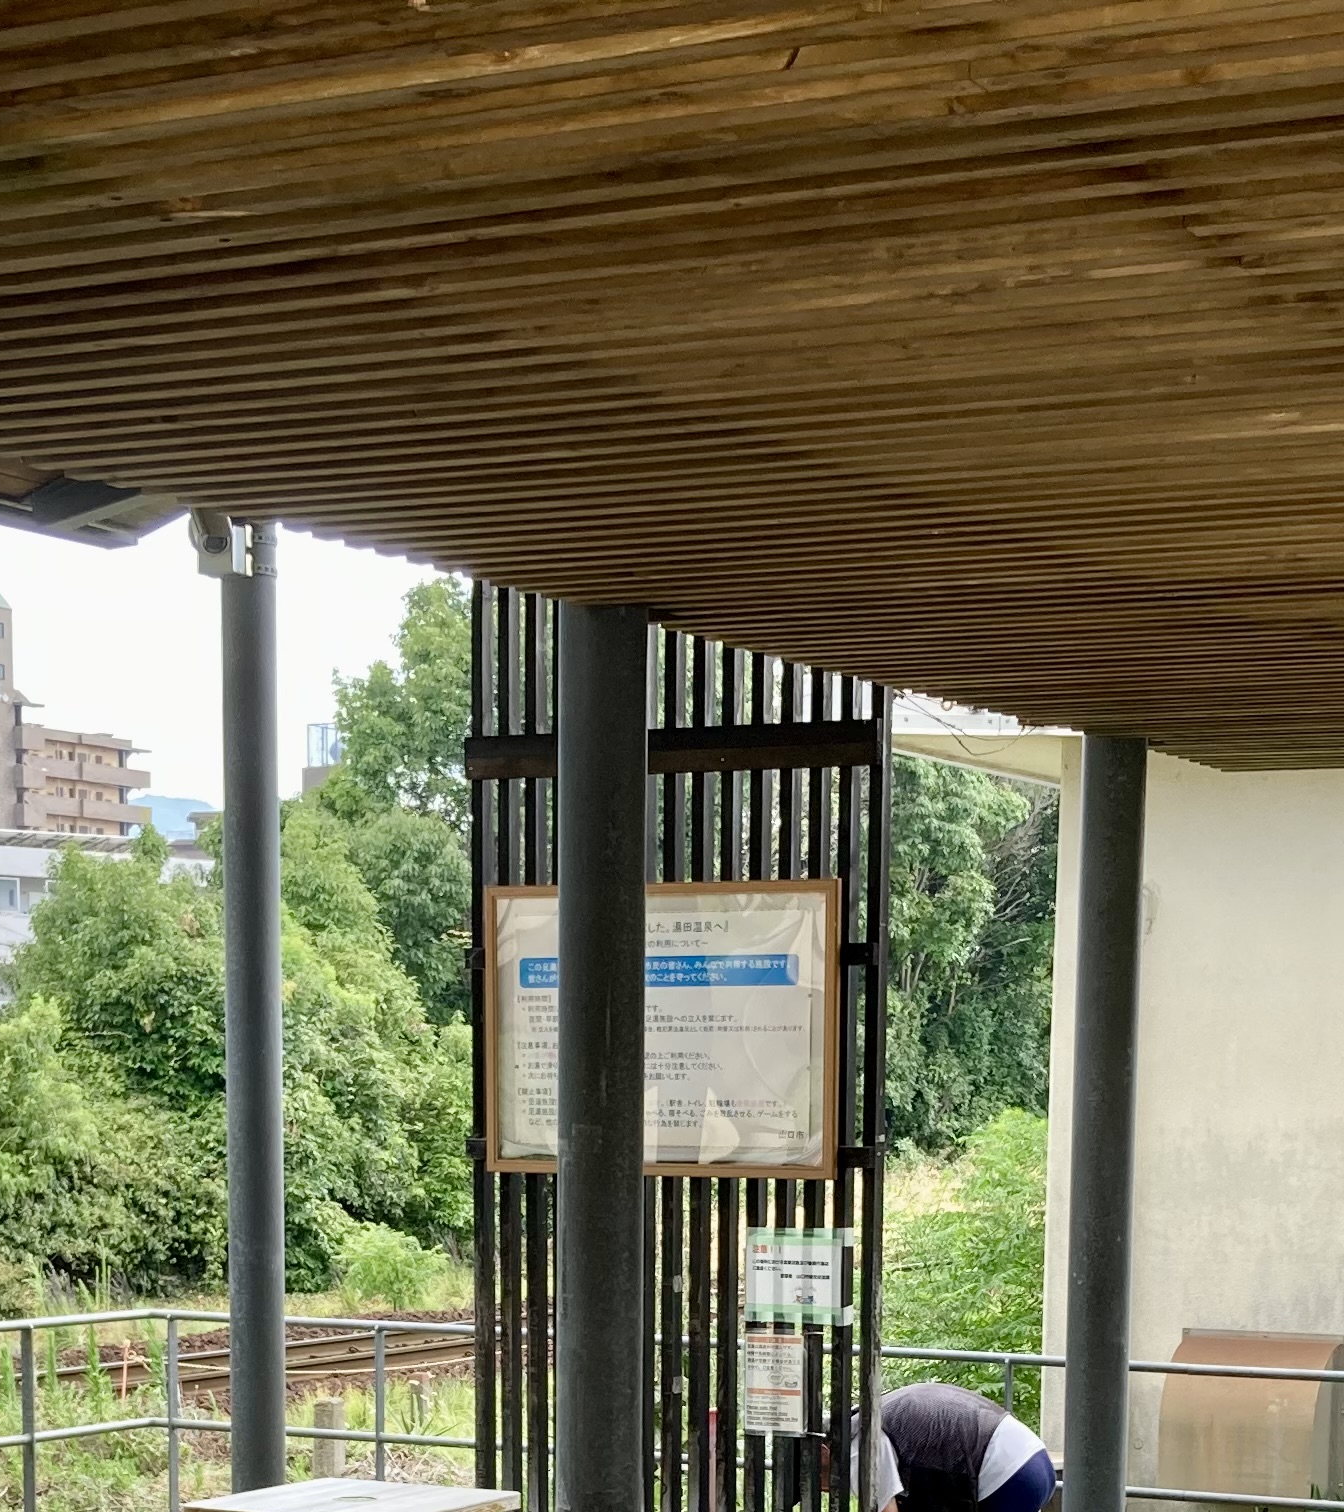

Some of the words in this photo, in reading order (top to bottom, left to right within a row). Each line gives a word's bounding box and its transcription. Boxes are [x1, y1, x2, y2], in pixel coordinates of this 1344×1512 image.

[645, 920, 729, 933] した。湯田温泉へ』
[778, 1130, 805, 1140] 山口市
